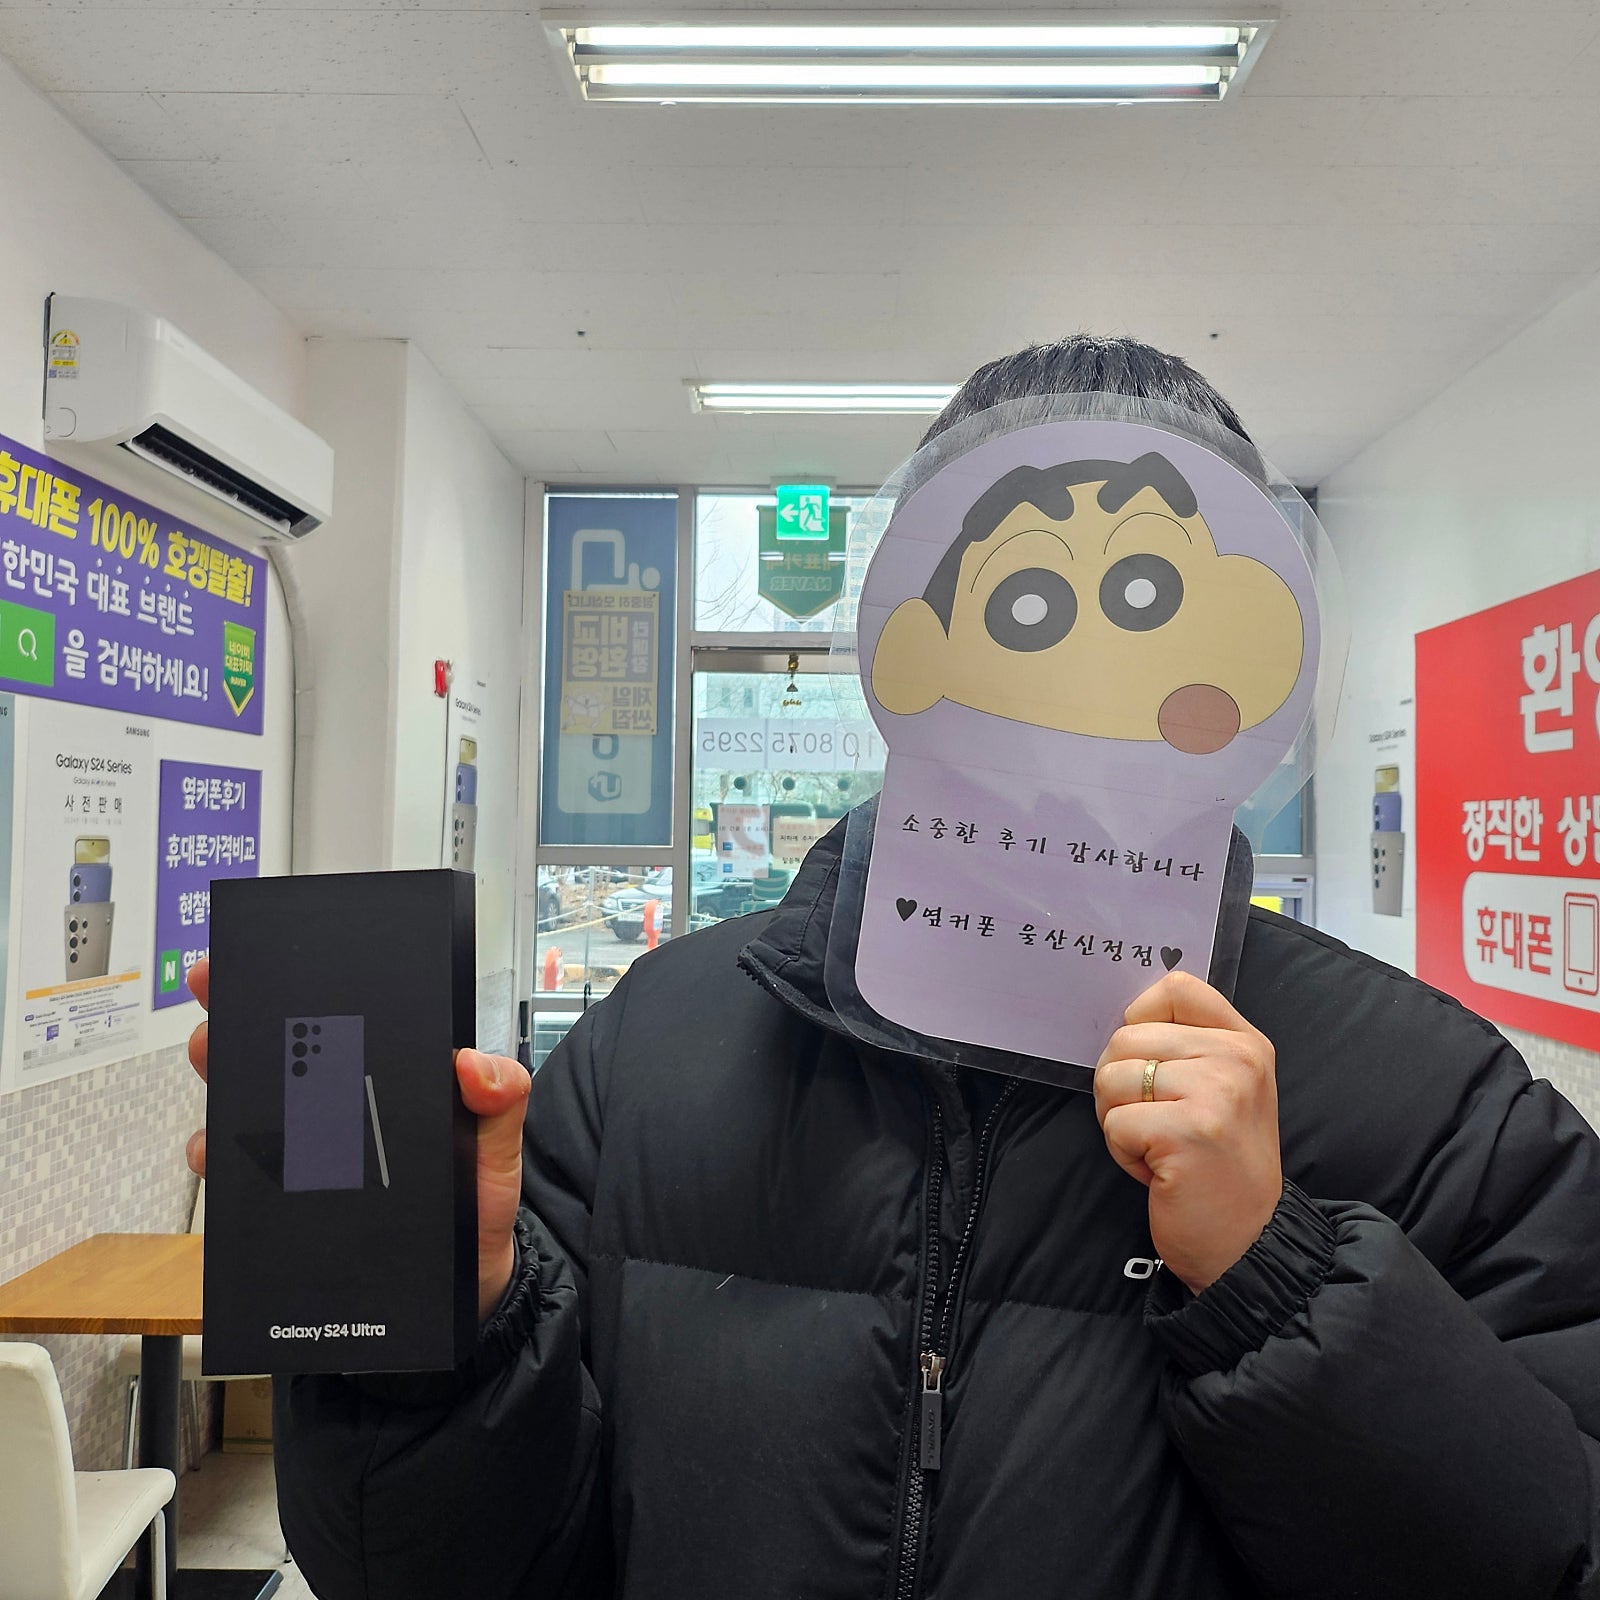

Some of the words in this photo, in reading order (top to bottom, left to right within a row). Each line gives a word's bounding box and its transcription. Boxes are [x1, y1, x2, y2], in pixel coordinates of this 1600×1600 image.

[88, 498, 159, 569] 100%
[163, 530, 254, 607] 호갱탈출!
[0, 538, 80, 606] 한민국
[86, 570, 131, 617] 대표
[136, 586, 195, 636] 브랜드
[97, 638, 209, 702] 검색하세요!
[126, 726, 150, 738] SAMSUNG
[56, 753, 89, 773] Galaxy
[90, 757, 105, 772] S24
[106, 759, 132, 774] Series
[183, 776, 246, 811] 옆커폰후기
[165, 833, 256, 868] 휴대폰가격비교
[902, 813, 979, 844] 소중한
[998, 827, 1048, 855] 후기
[1066, 840, 1205, 882] 감사합니다
[1461, 796, 1544, 862] 정직한
[179, 891, 210, 926] 현찰
[921, 905, 996, 937] 옆커폰
[1018, 922, 1153, 968] 울산신정점
[1476, 906, 1552, 976] 휴대폰
[1123, 1257, 1164, 1280] O'
[270, 1325, 322, 1341] Galaxy
[323, 1323, 349, 1338] S24
[351, 1323, 386, 1337] Ultra
